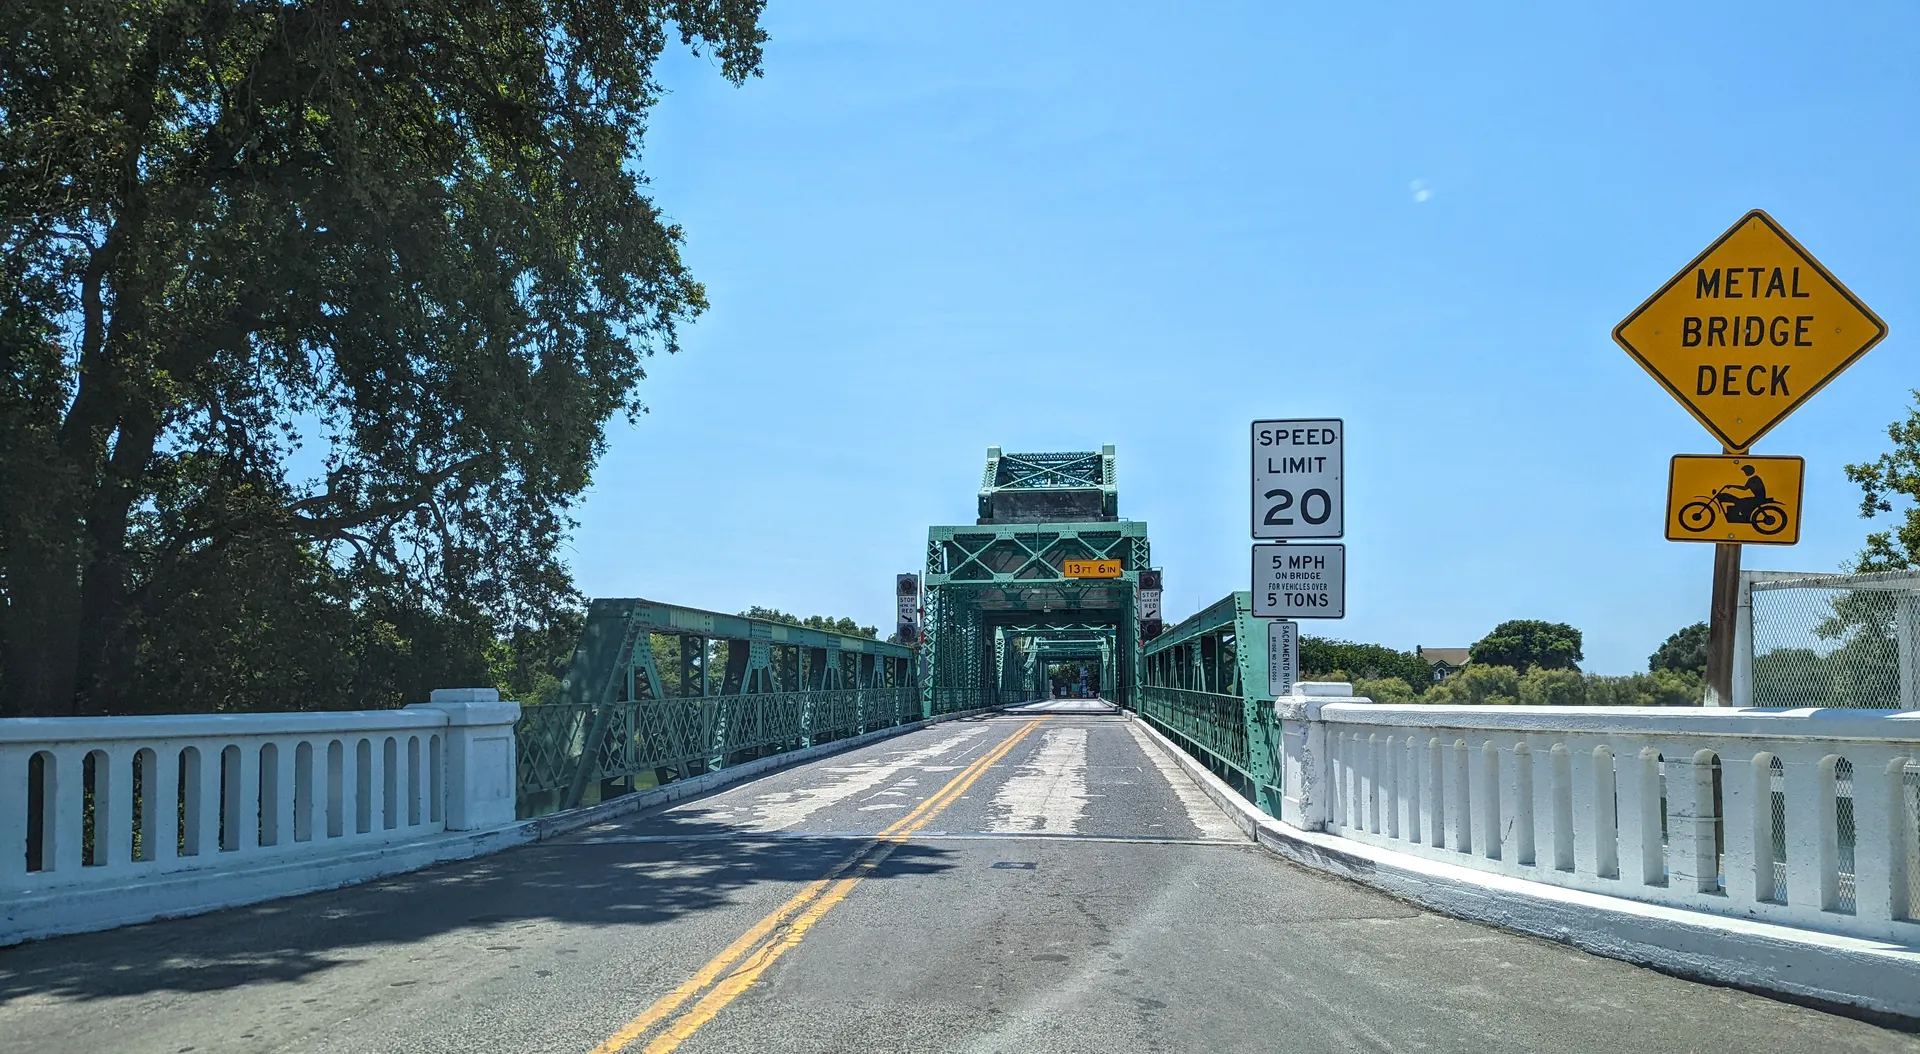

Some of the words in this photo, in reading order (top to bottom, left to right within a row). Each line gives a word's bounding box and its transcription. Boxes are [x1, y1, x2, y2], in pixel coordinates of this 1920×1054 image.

[1696, 267, 1810, 299] METAL
[1682, 315, 1814, 347] BRIDGE
[1696, 365, 1791, 396] DECK
[1260, 429, 1335, 446] SPEED
[1268, 457, 1326, 473] LIMIT
[1263, 488, 1332, 525] 20
[1069, 564, 1080, 574] 13
[1082, 566, 1091, 574] FT
[1098, 564, 1106, 574] 6
[1272, 555, 1282, 569] 5
[1289, 555, 1325, 569] MPH
[1275, 572, 1287, 580] ON
[1290, 572, 1321, 580] BRIDGE
[1268, 583, 1281, 591] FOR
[1282, 583, 1311, 591] VEHICLES
[1312, 583, 1328, 591] OVER
[1267, 593, 1277, 607] 5
[1284, 593, 1329, 607] TONS
[1282, 625, 1290, 670] SACRAMENTO
[1282, 672, 1290, 694] RIVER
